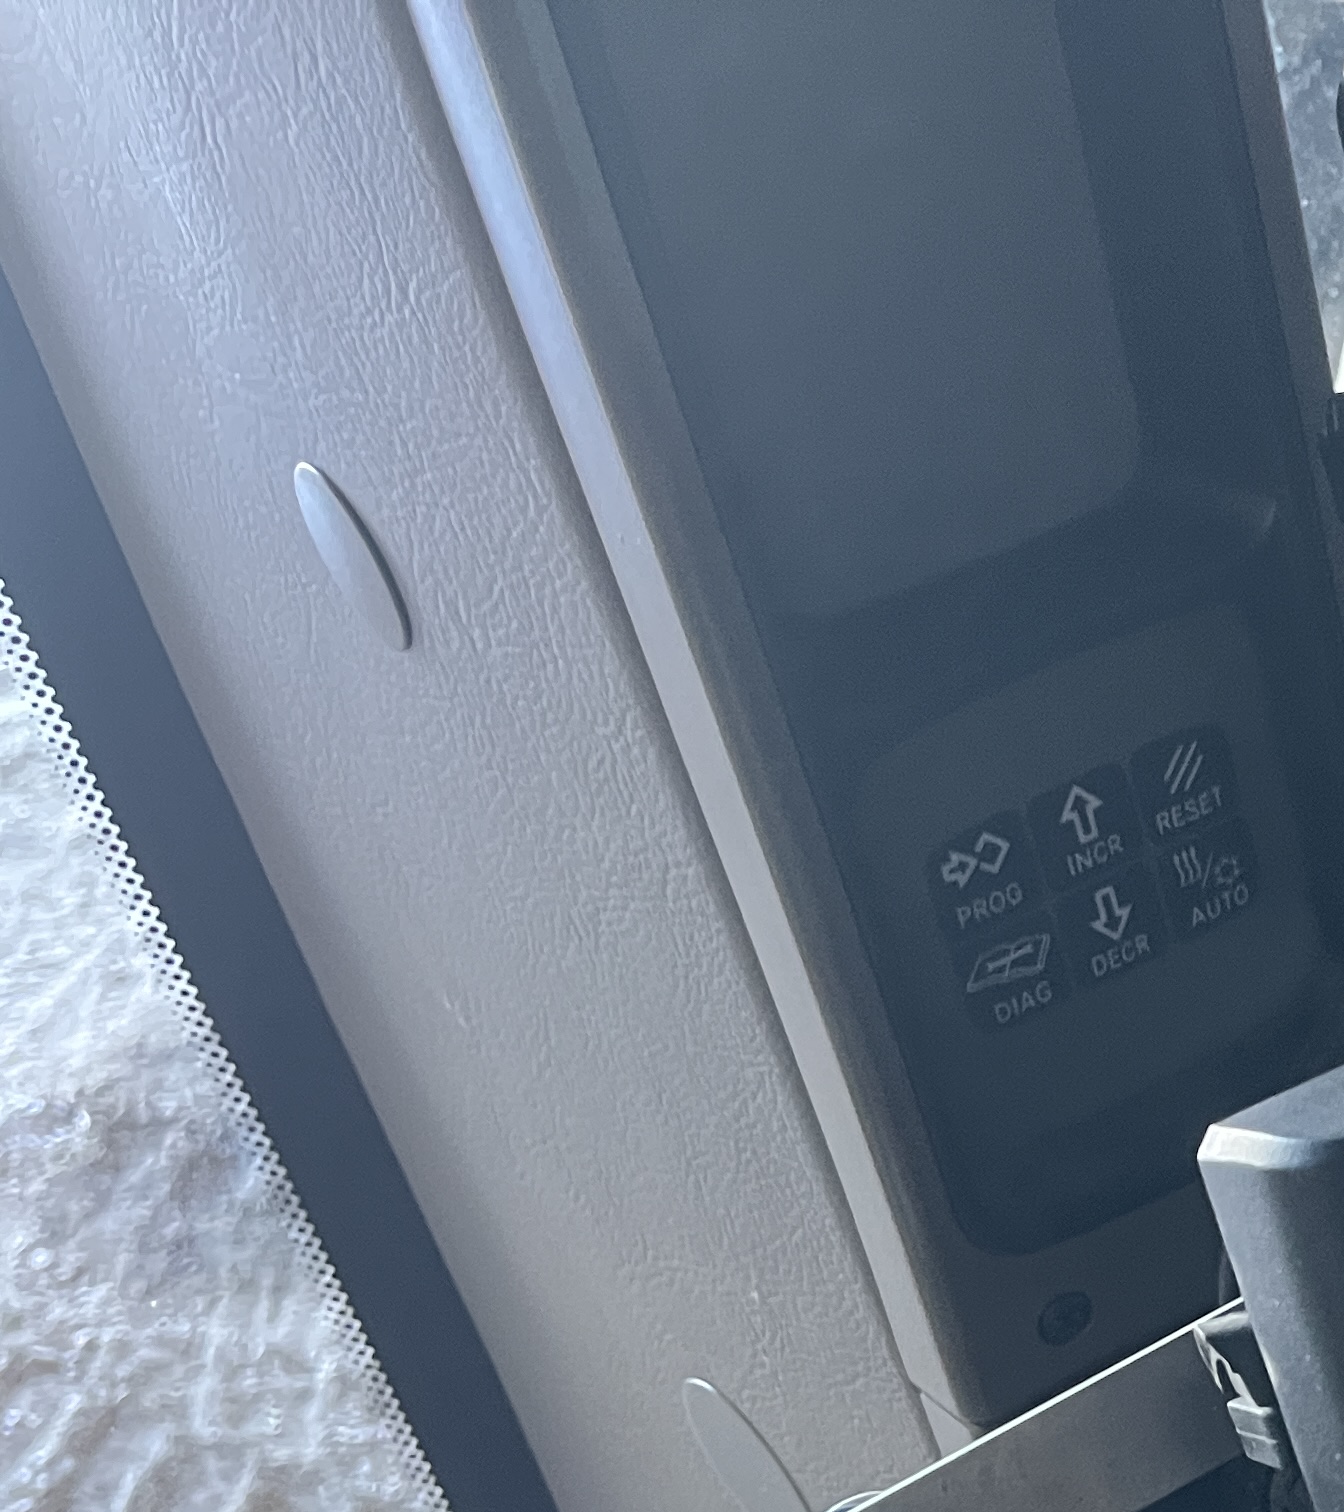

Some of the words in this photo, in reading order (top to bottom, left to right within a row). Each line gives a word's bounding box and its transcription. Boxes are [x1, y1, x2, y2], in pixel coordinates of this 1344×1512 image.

[1156, 785, 1225, 835] RESET
[1066, 834, 1124, 876] INCR
[1191, 884, 1249, 928] AUTO
[1091, 934, 1150, 977] DECR
[994, 981, 1053, 1023] DIAG
